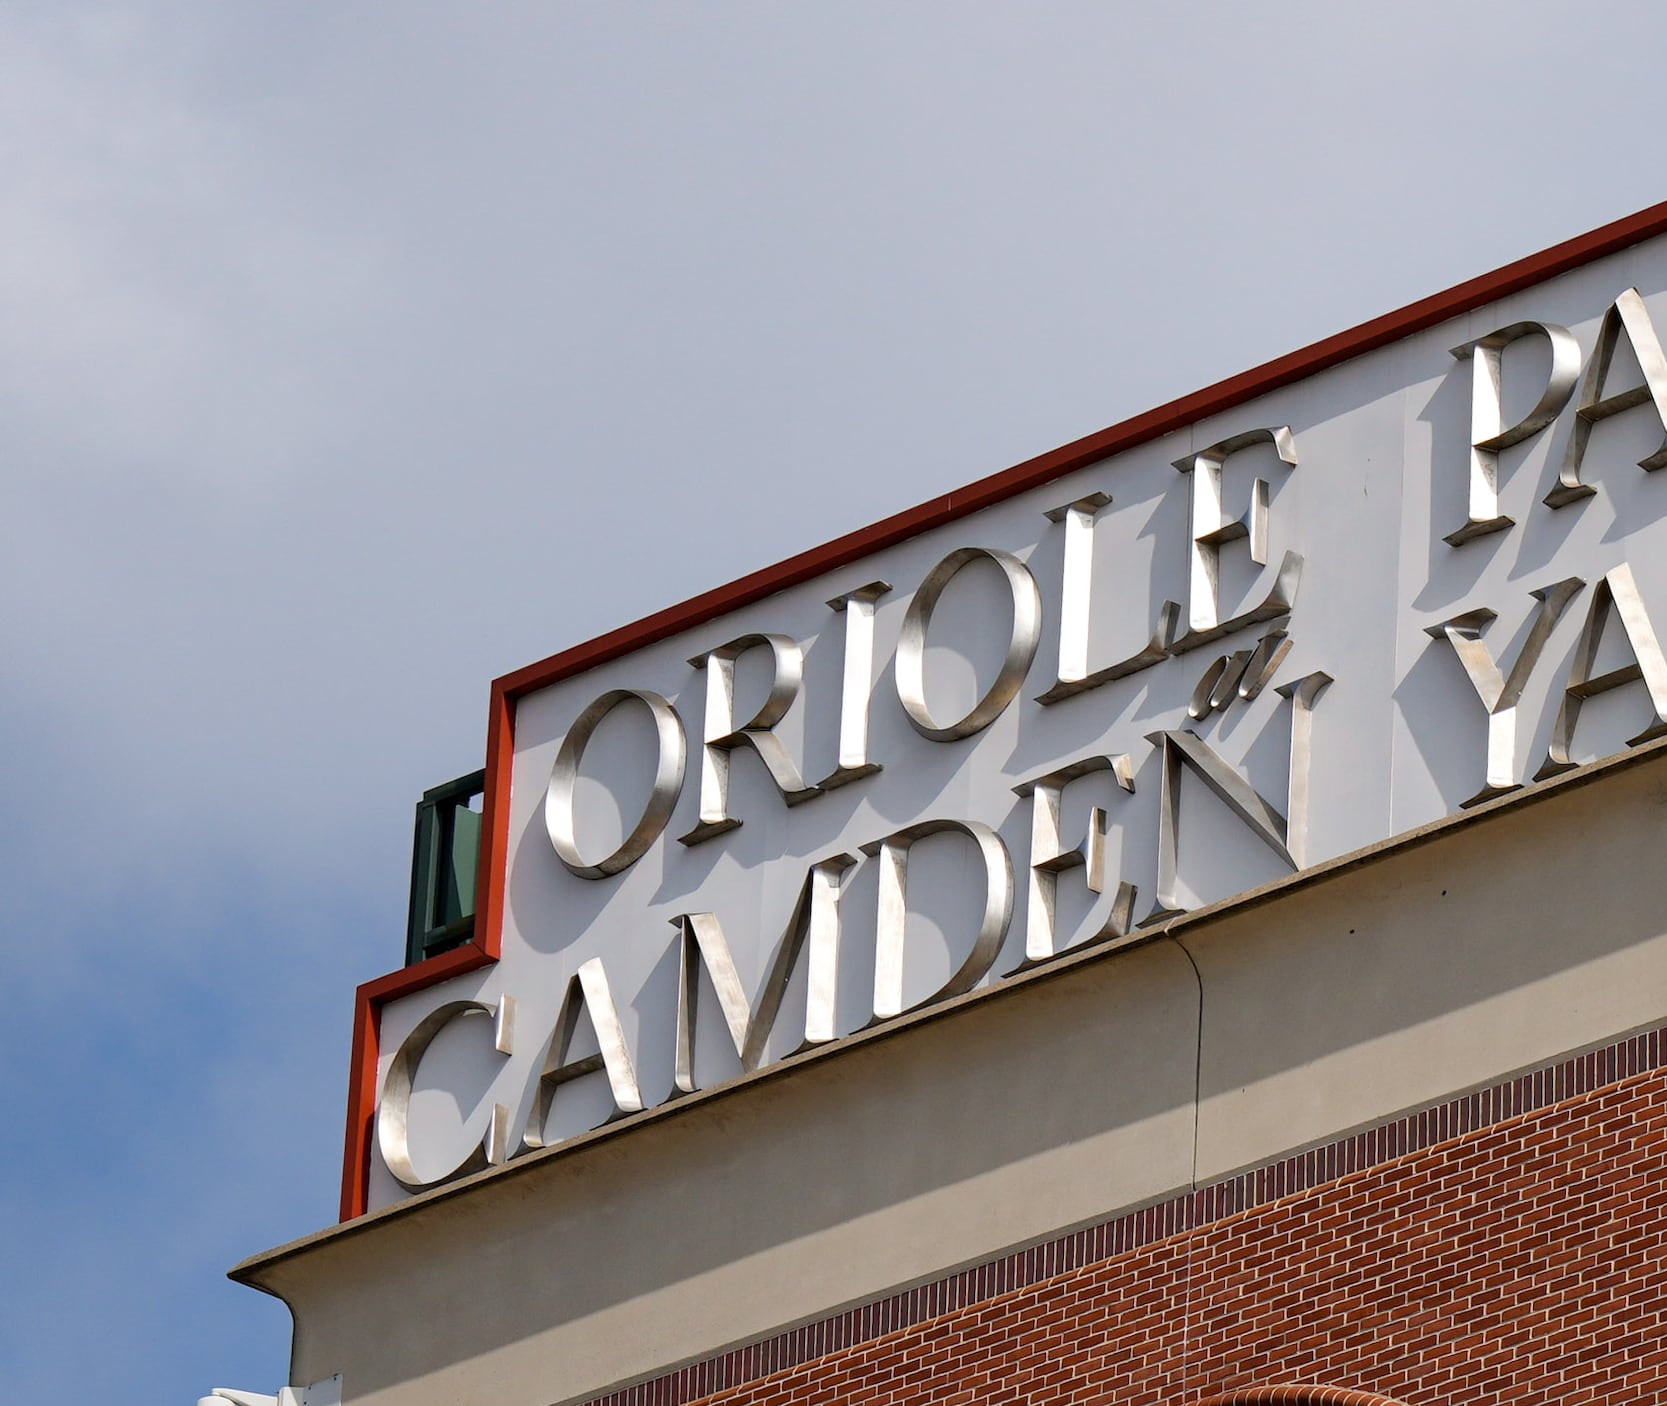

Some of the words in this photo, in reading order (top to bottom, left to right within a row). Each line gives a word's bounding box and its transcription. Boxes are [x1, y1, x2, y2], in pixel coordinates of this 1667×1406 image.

[544, 425, 1305, 879] ORIOLE
[1188, 628, 1294, 721] at
[377, 670, 1334, 1193] CAMDEN
